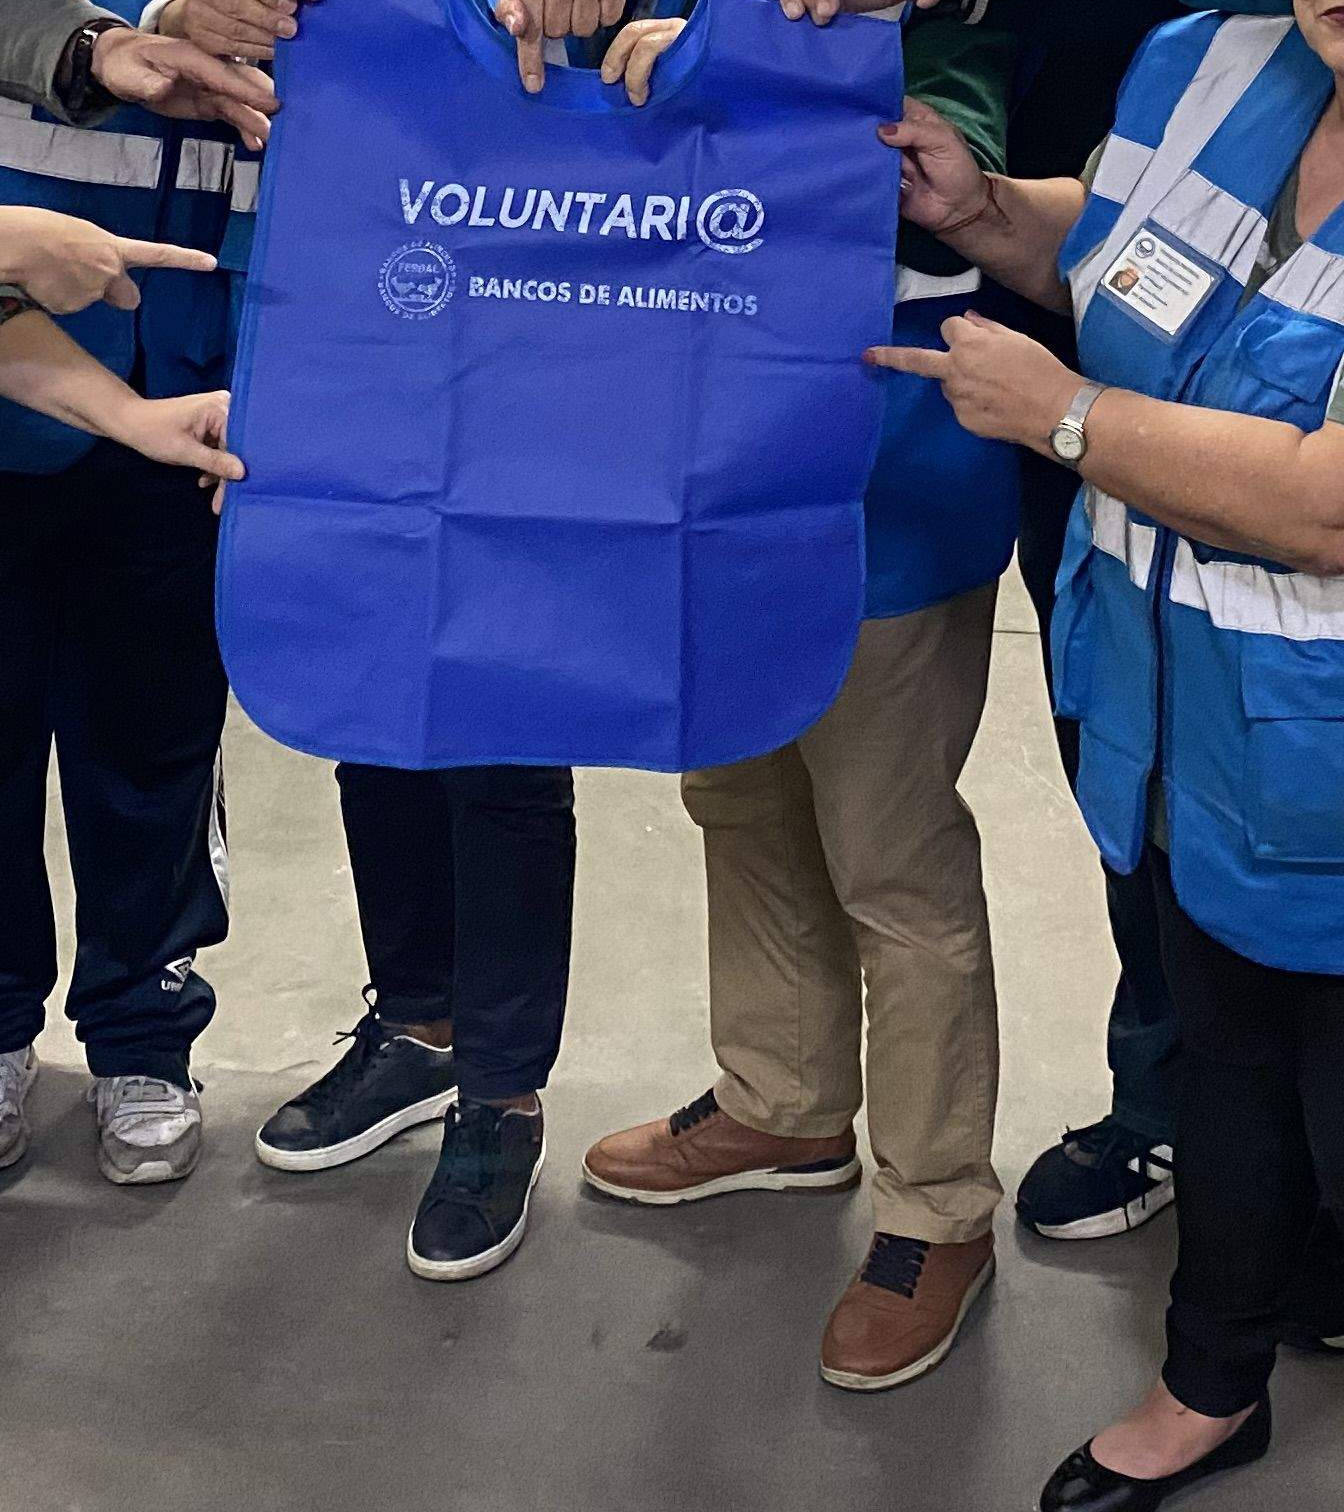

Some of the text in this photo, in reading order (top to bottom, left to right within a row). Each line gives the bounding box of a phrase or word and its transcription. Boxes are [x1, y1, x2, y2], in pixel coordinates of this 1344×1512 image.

[398, 178, 766, 255] VOLUNTARI@
[468, 275, 759, 317] BANCOS DE ALIMENTOS
